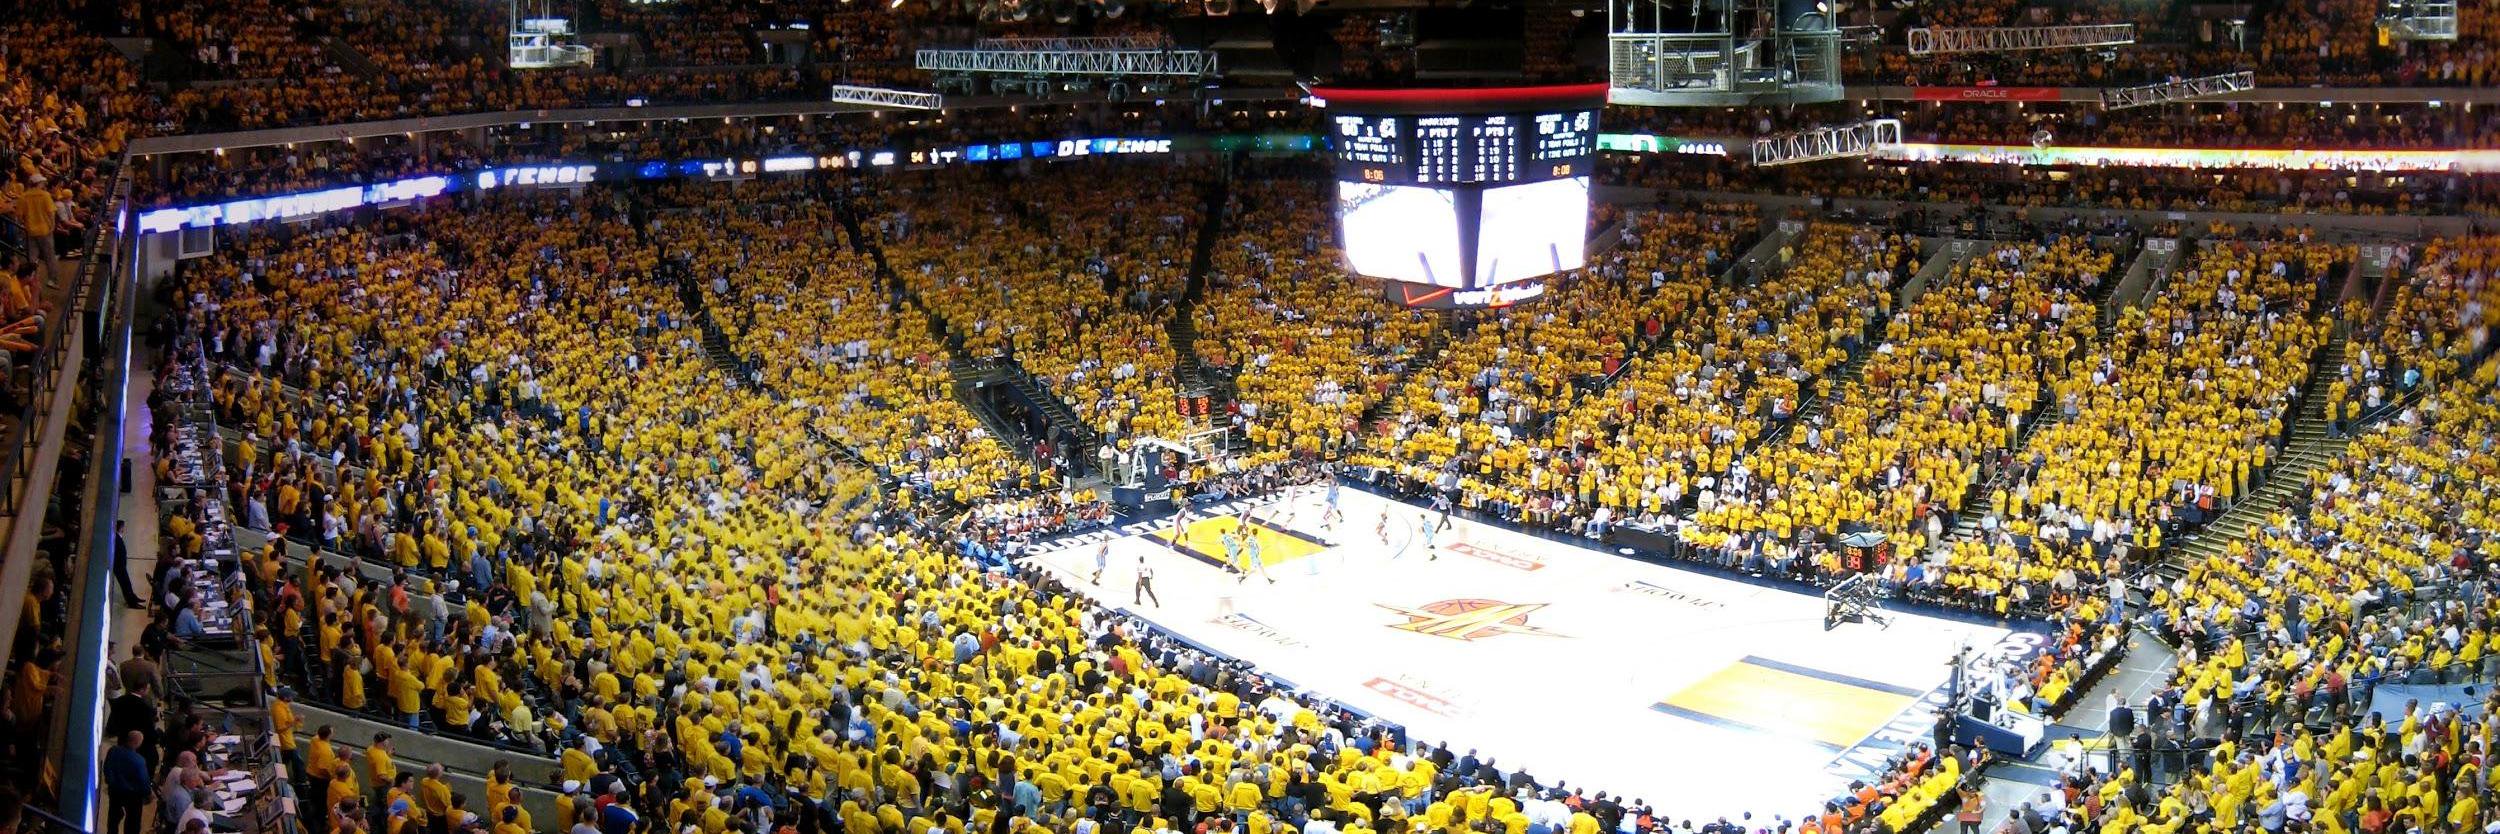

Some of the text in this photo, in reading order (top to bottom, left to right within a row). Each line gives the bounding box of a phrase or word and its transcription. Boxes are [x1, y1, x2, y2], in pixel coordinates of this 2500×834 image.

[1963, 90, 2007, 98] ORACLE
[1419, 118, 1459, 126] WARRIORS
[1485, 116, 1506, 125] JAZZ
[1417, 129, 1426, 138] P
[1429, 128, 1449, 138] PTS
[1473, 127, 1481, 137] P
[1486, 127, 1506, 137] PTS
[1056, 138, 1171, 158] DE FENSE
[911, 152, 923, 162] 54
